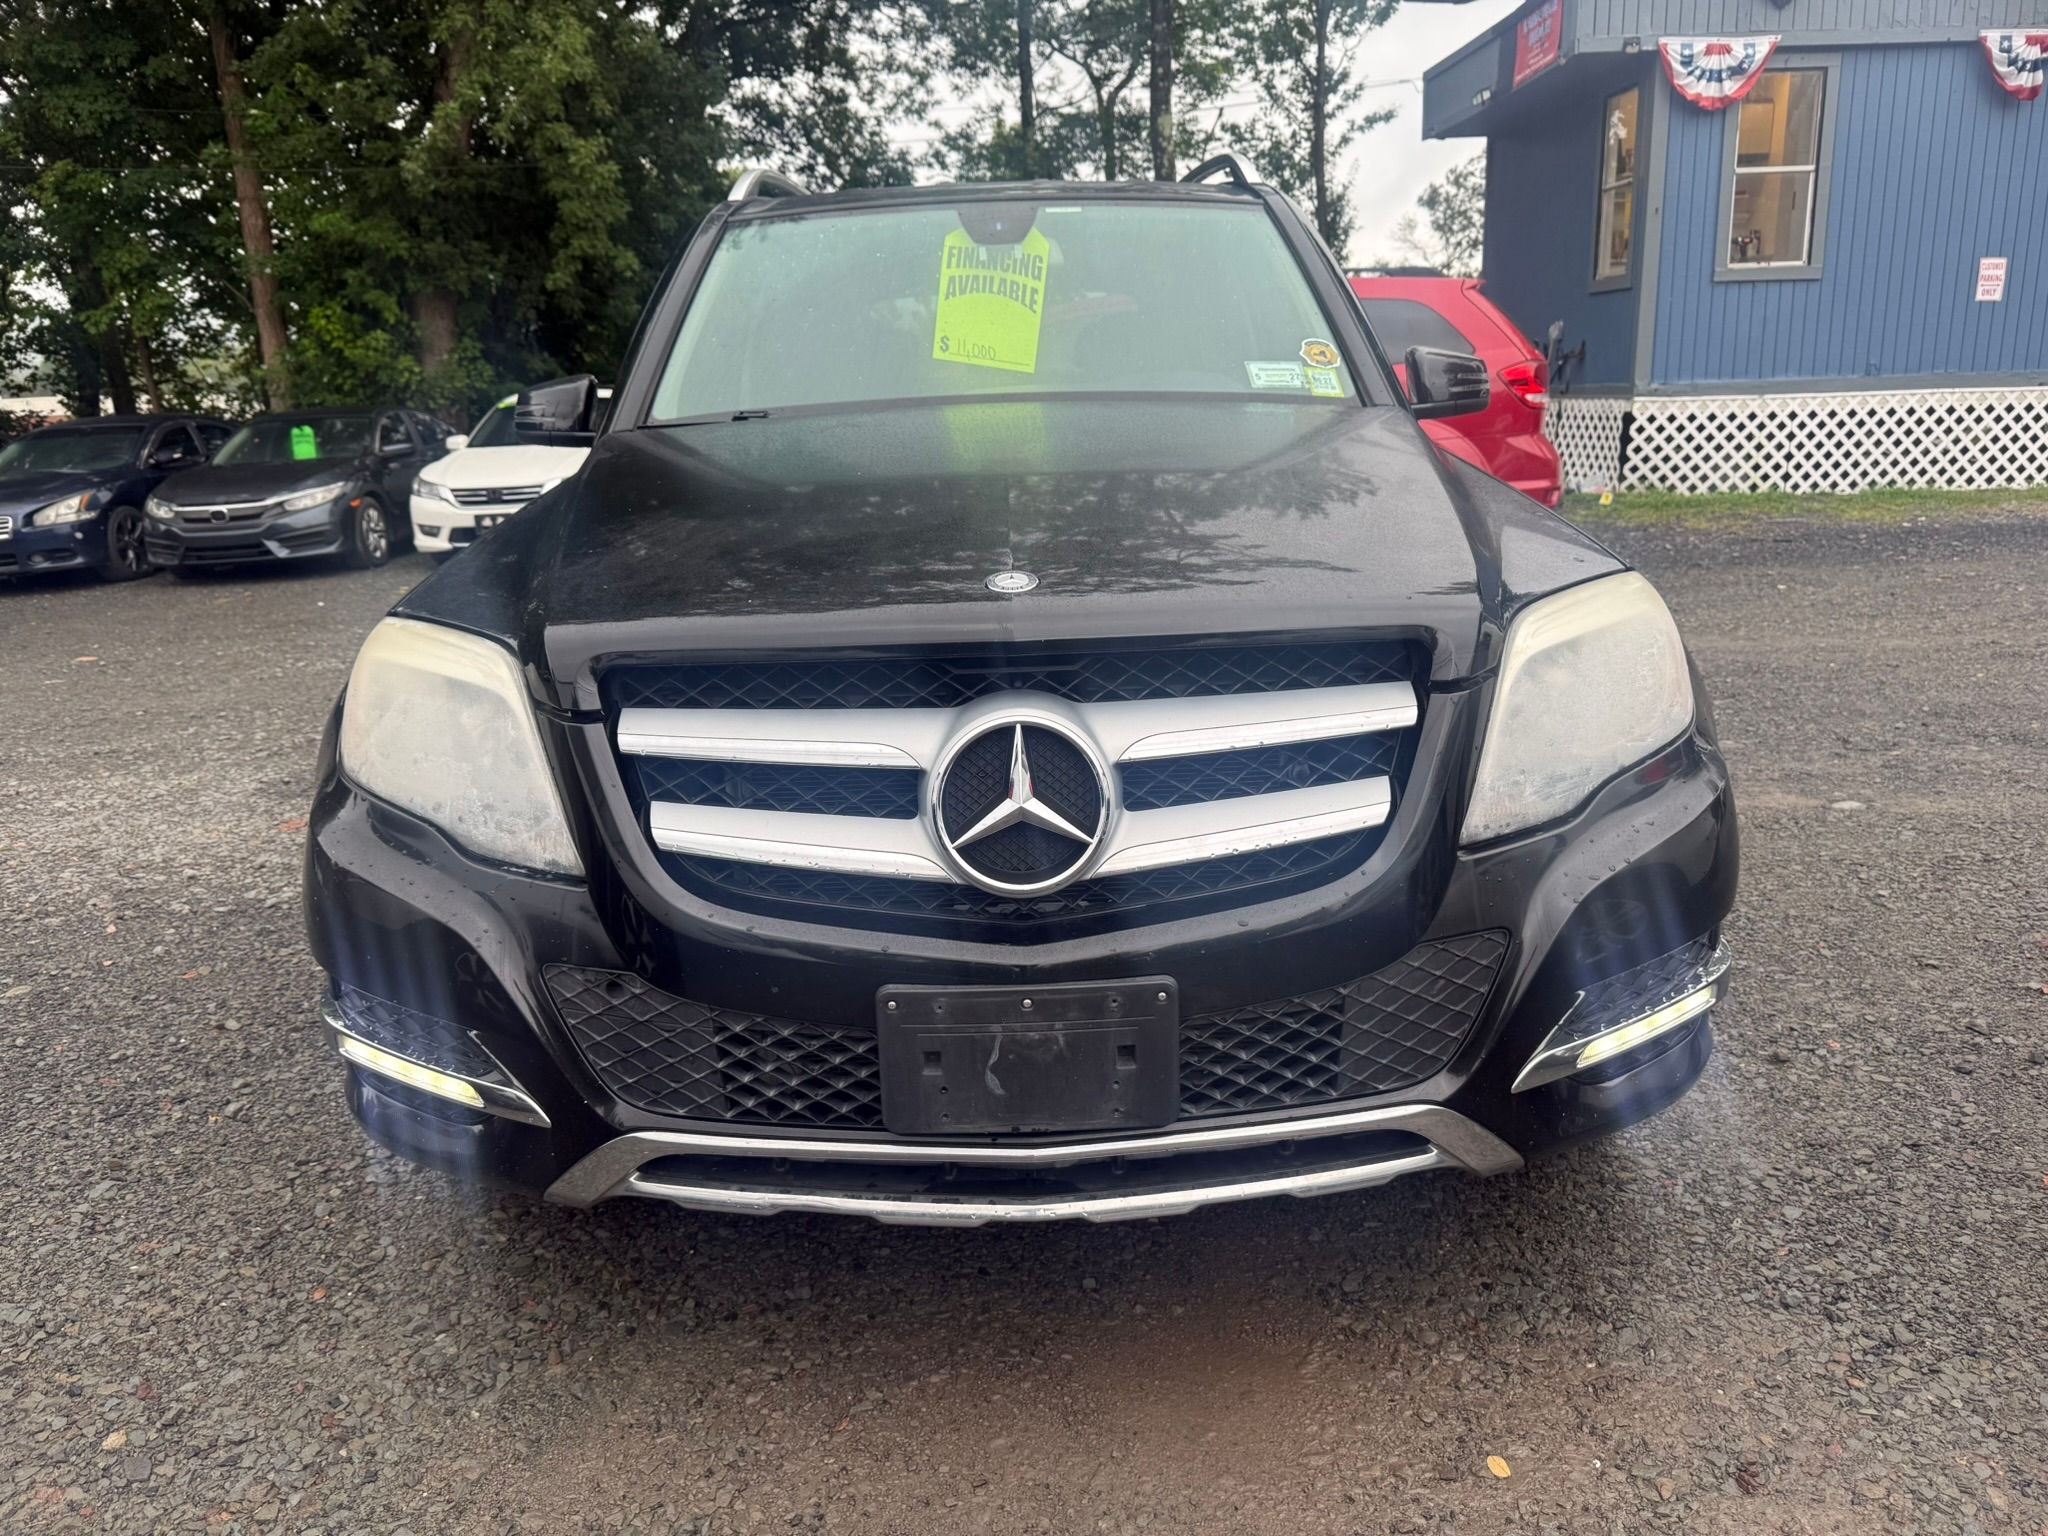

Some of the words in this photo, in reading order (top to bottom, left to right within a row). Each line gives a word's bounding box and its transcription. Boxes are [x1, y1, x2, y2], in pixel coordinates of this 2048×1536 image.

[946, 246, 1044, 282] FINANCING
[1982, 262, 2004, 270] CUSTOMER
[1980, 274, 2002, 282] PARKING
[945, 275, 1039, 314] AVAILABLE
[1981, 288, 1996, 296] ONLY
[940, 335, 950, 352] $
[957, 338, 996, 360] 11,000
